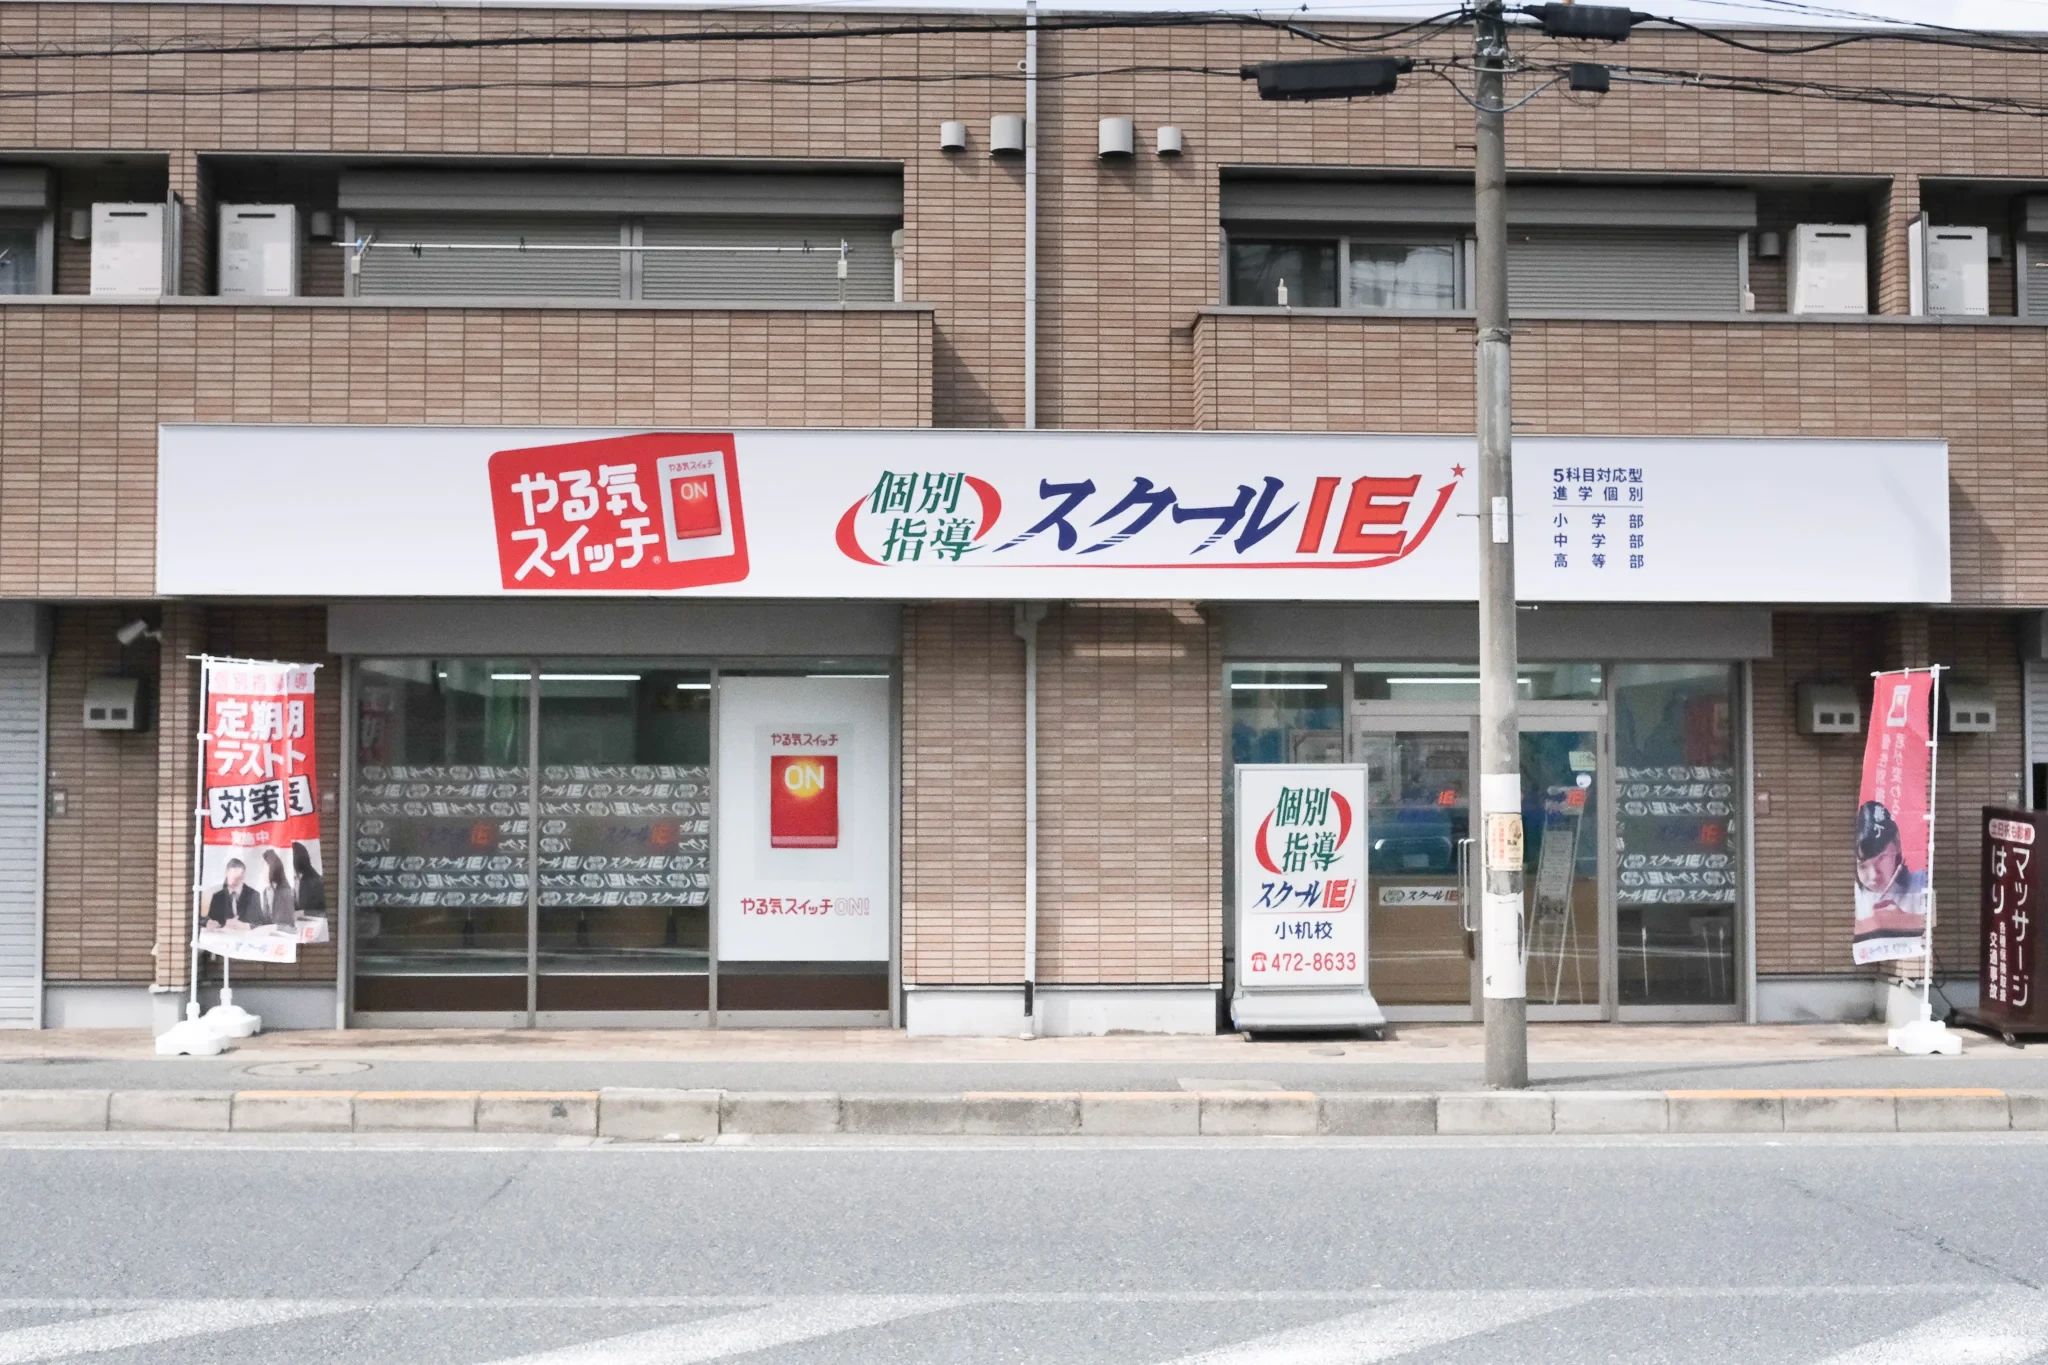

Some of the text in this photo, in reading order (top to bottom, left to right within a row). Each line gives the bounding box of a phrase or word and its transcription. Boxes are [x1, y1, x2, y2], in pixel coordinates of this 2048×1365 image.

[667, 458, 715, 473] やる気スイッチ
[1553, 467, 1643, 483] 5科目対応型
[511, 463, 648, 526] やる気
[680, 480, 709, 501] ON
[868, 470, 965, 514] 個別
[1553, 486, 1643, 502] 進学個別
[993, 474, 1422, 555] スクールIE
[1553, 513, 1644, 529] 小学部
[511, 516, 660, 582] スイッチ
[882, 517, 983, 562] 指導
[1553, 533, 1644, 549] 中学部
[1553, 553, 1644, 569] 高等部
[215, 698, 284, 741] 定期
[770, 733, 839, 747] やる気スイッチ
[213, 740, 286, 779] テスト
[784, 764, 825, 790] ON
[218, 784, 281, 824] 対策
[1275, 786, 1331, 827] 個別
[1282, 831, 1344, 873] 指導
[1251, 878, 1351, 909] スクールIE
[1991, 844, 2007, 914] はり
[1275, 921, 1333, 940] 小机校
[2012, 847, 2030, 1006] マッサージ
[1271, 951, 1357, 972] 472-8633
